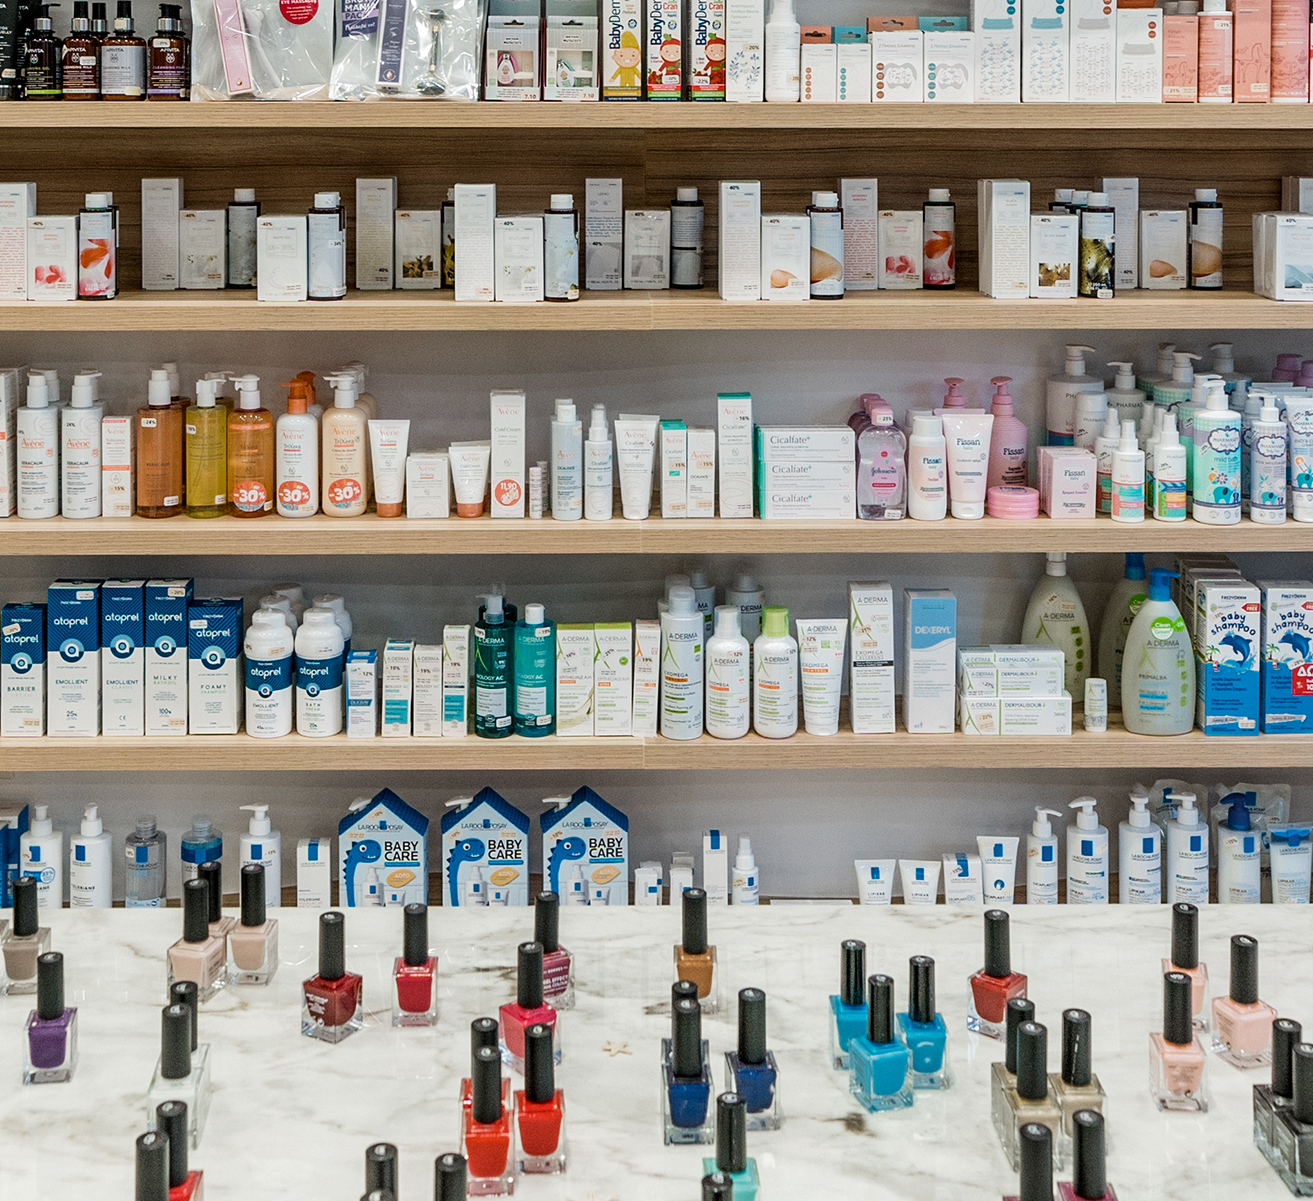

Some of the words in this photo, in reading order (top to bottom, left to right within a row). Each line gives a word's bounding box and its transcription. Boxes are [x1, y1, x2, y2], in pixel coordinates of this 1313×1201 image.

[957, 437, 981, 447] Fissan
[1064, 469, 1085, 477] Fissan
[104, 612, 139, 624] atoprel
[148, 612, 183, 624] atoprel
[1220, 611, 1246, 624] baby
[1279, 610, 1305, 622] baby
[53, 617, 88, 629] atoprel
[1211, 621, 1257, 637] shampoo
[196, 628, 231, 640] atoprel
[914, 625, 952, 635] DEXERYL
[4, 634, 39, 646] atoprel
[250, 666, 282, 679] atoprel
[299, 667, 330, 679] atoprel
[384, 841, 419, 851] BABY
[487, 839, 522, 850] BABY
[589, 838, 624, 848] BABY
[384, 851, 419, 861] CARE
[487, 849, 522, 859] CARE
[589, 847, 623, 858] CARE
